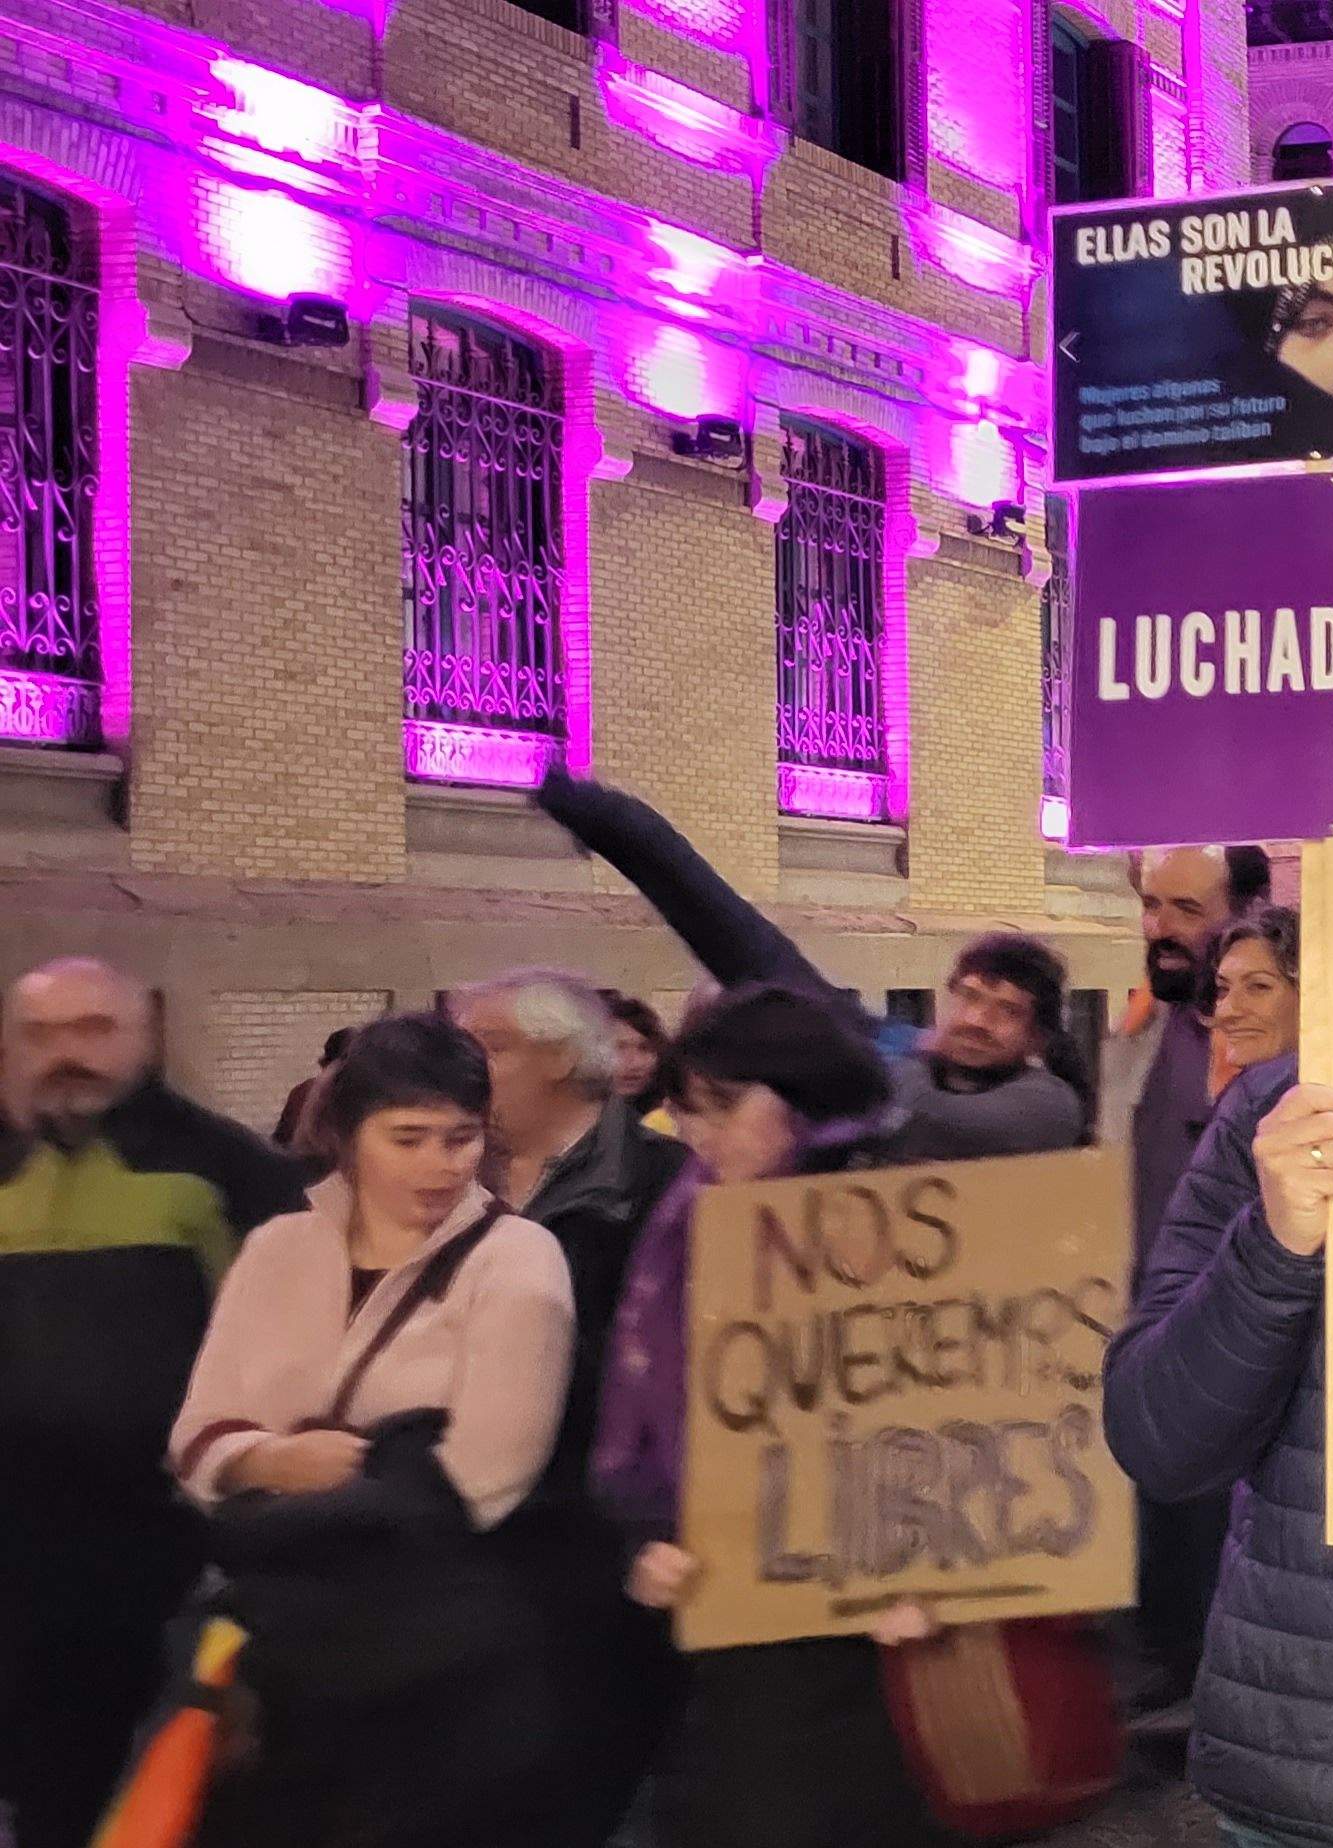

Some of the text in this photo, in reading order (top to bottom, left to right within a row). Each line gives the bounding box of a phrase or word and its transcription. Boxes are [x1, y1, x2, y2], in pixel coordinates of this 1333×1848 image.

[1076, 206, 1297, 266] ELLAS SON LA
[753, 1175, 962, 1314] NOS
